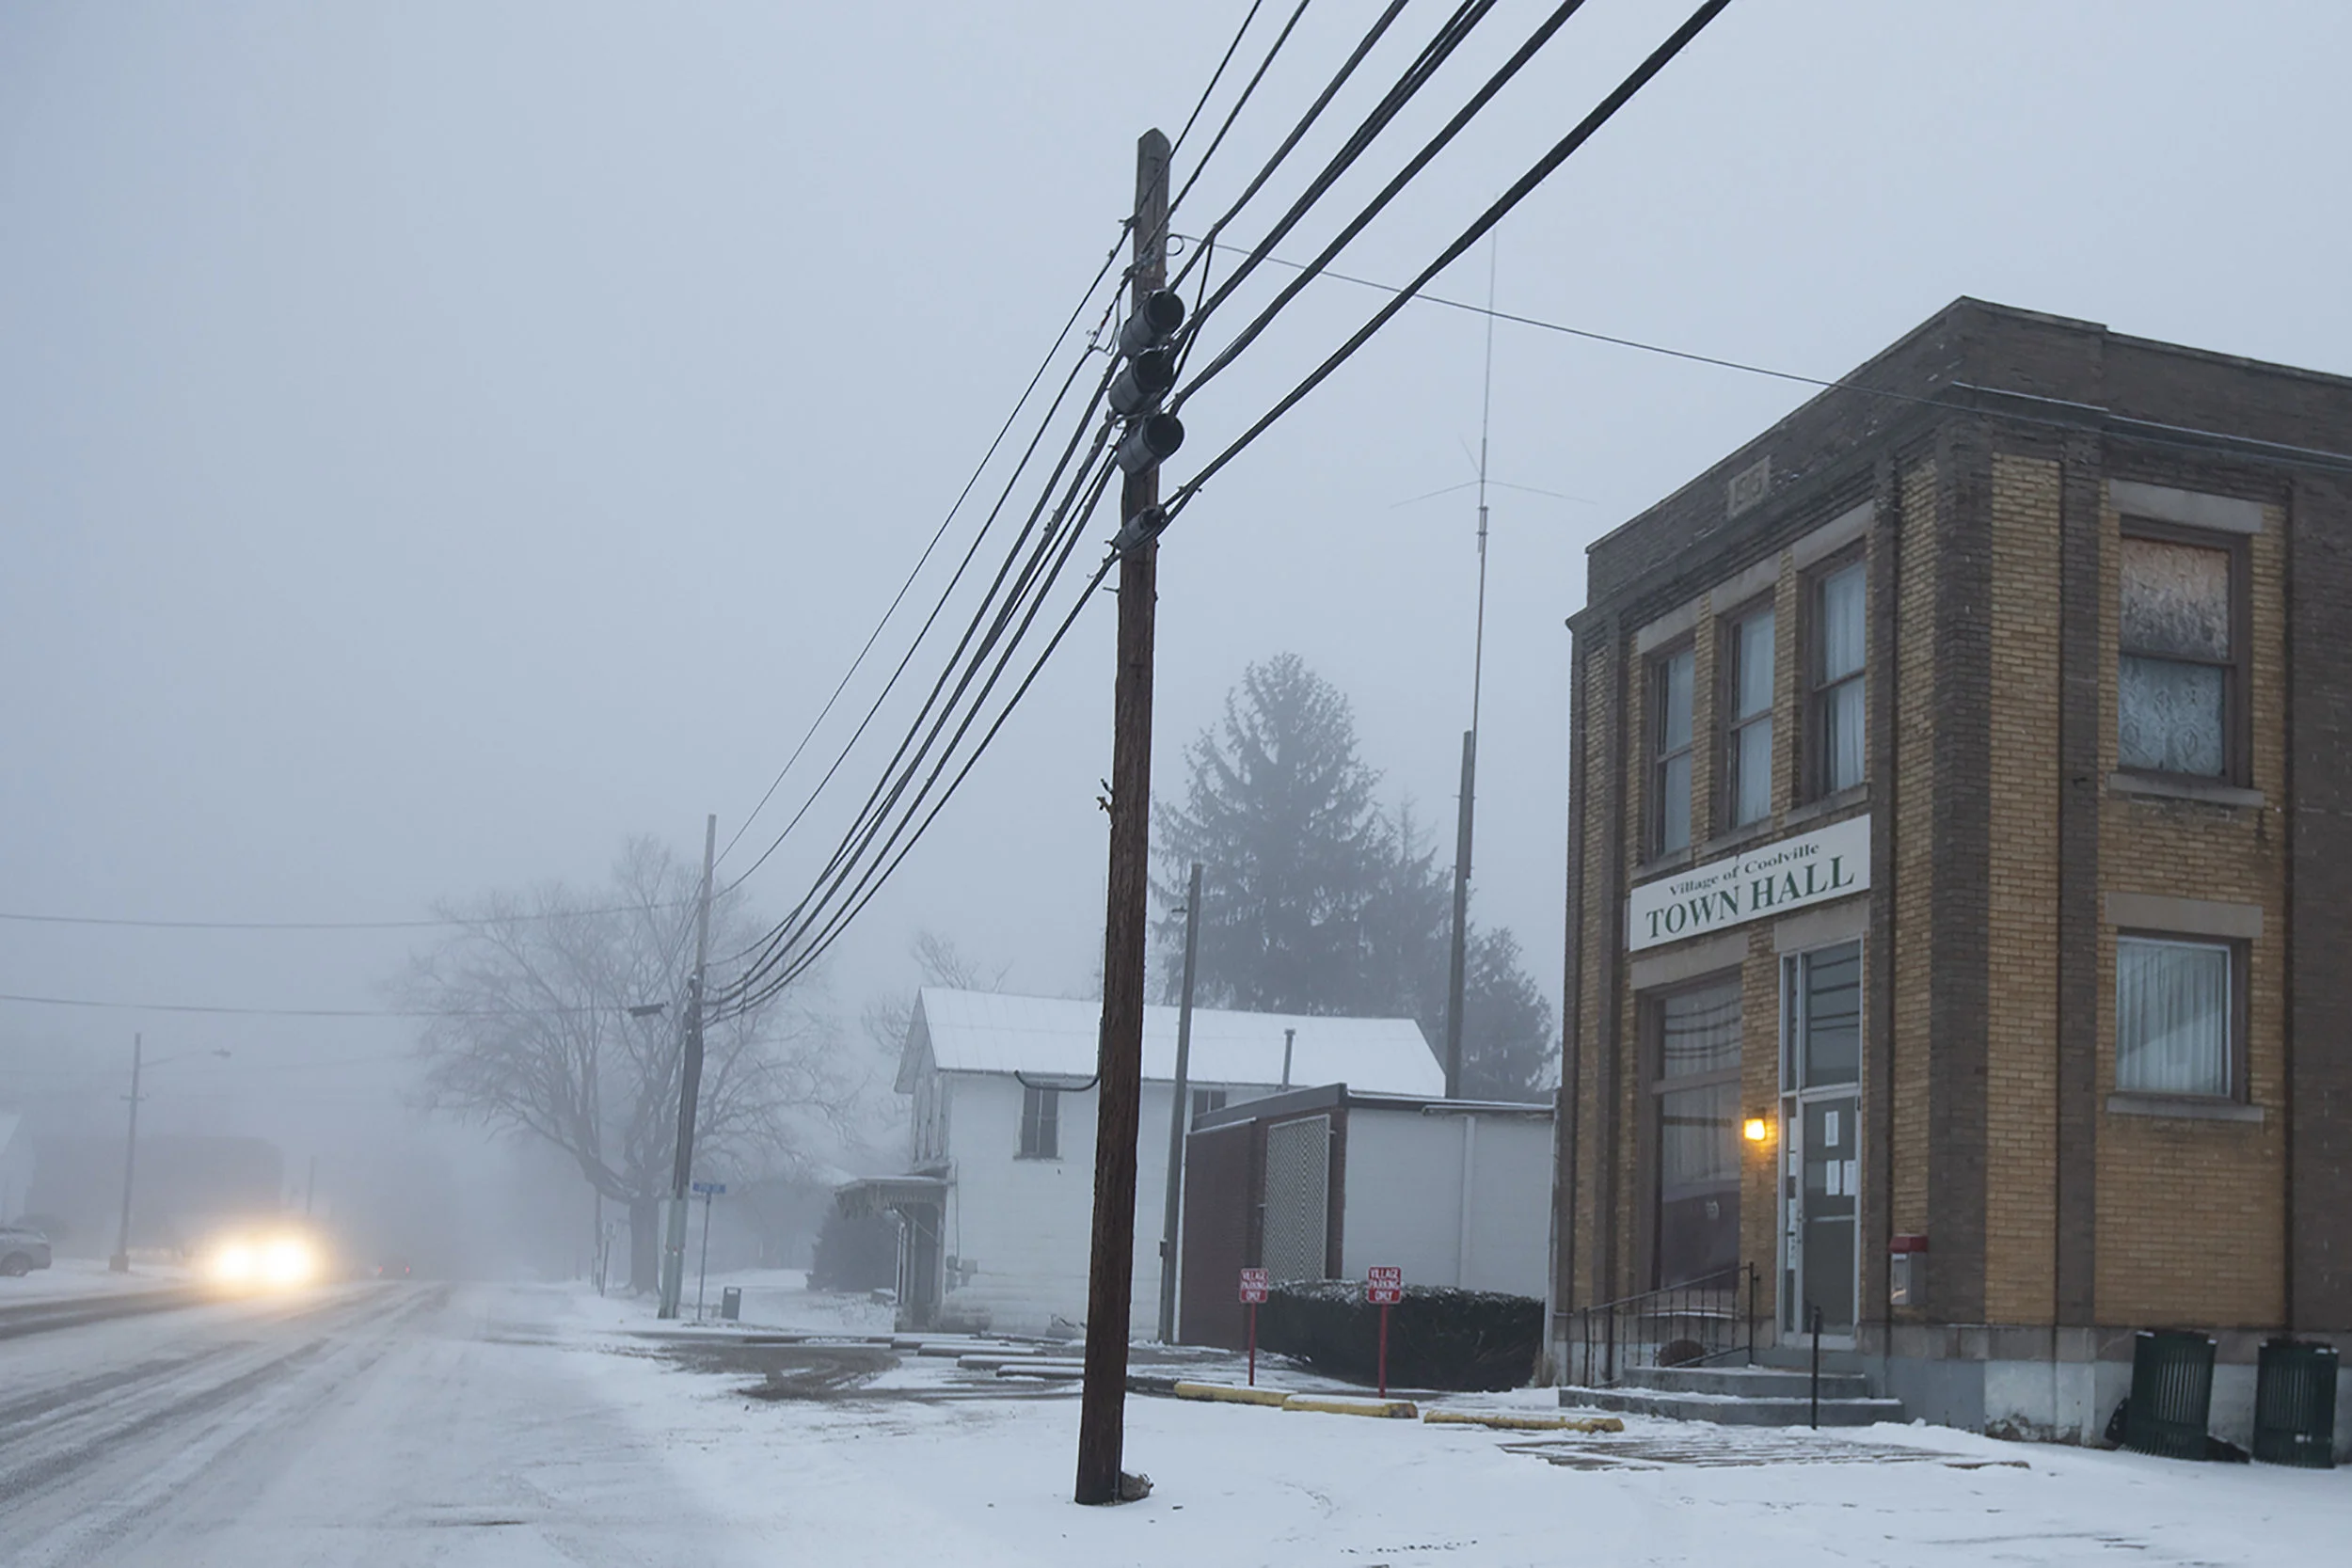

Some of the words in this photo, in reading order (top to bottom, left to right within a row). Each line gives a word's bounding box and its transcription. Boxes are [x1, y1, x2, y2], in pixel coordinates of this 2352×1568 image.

[1670, 875, 1718, 896] Village
[1723, 864, 1740, 880] of
[1744, 842, 1820, 874] Coolville
[1646, 885, 1741, 939] TOWN
[1750, 854, 1855, 912] HALL
[1242, 1271, 1266, 1280] VILLAGE
[1370, 1269, 1398, 1279] VILLAGE
[1375, 1291, 1393, 1302] ONLY
